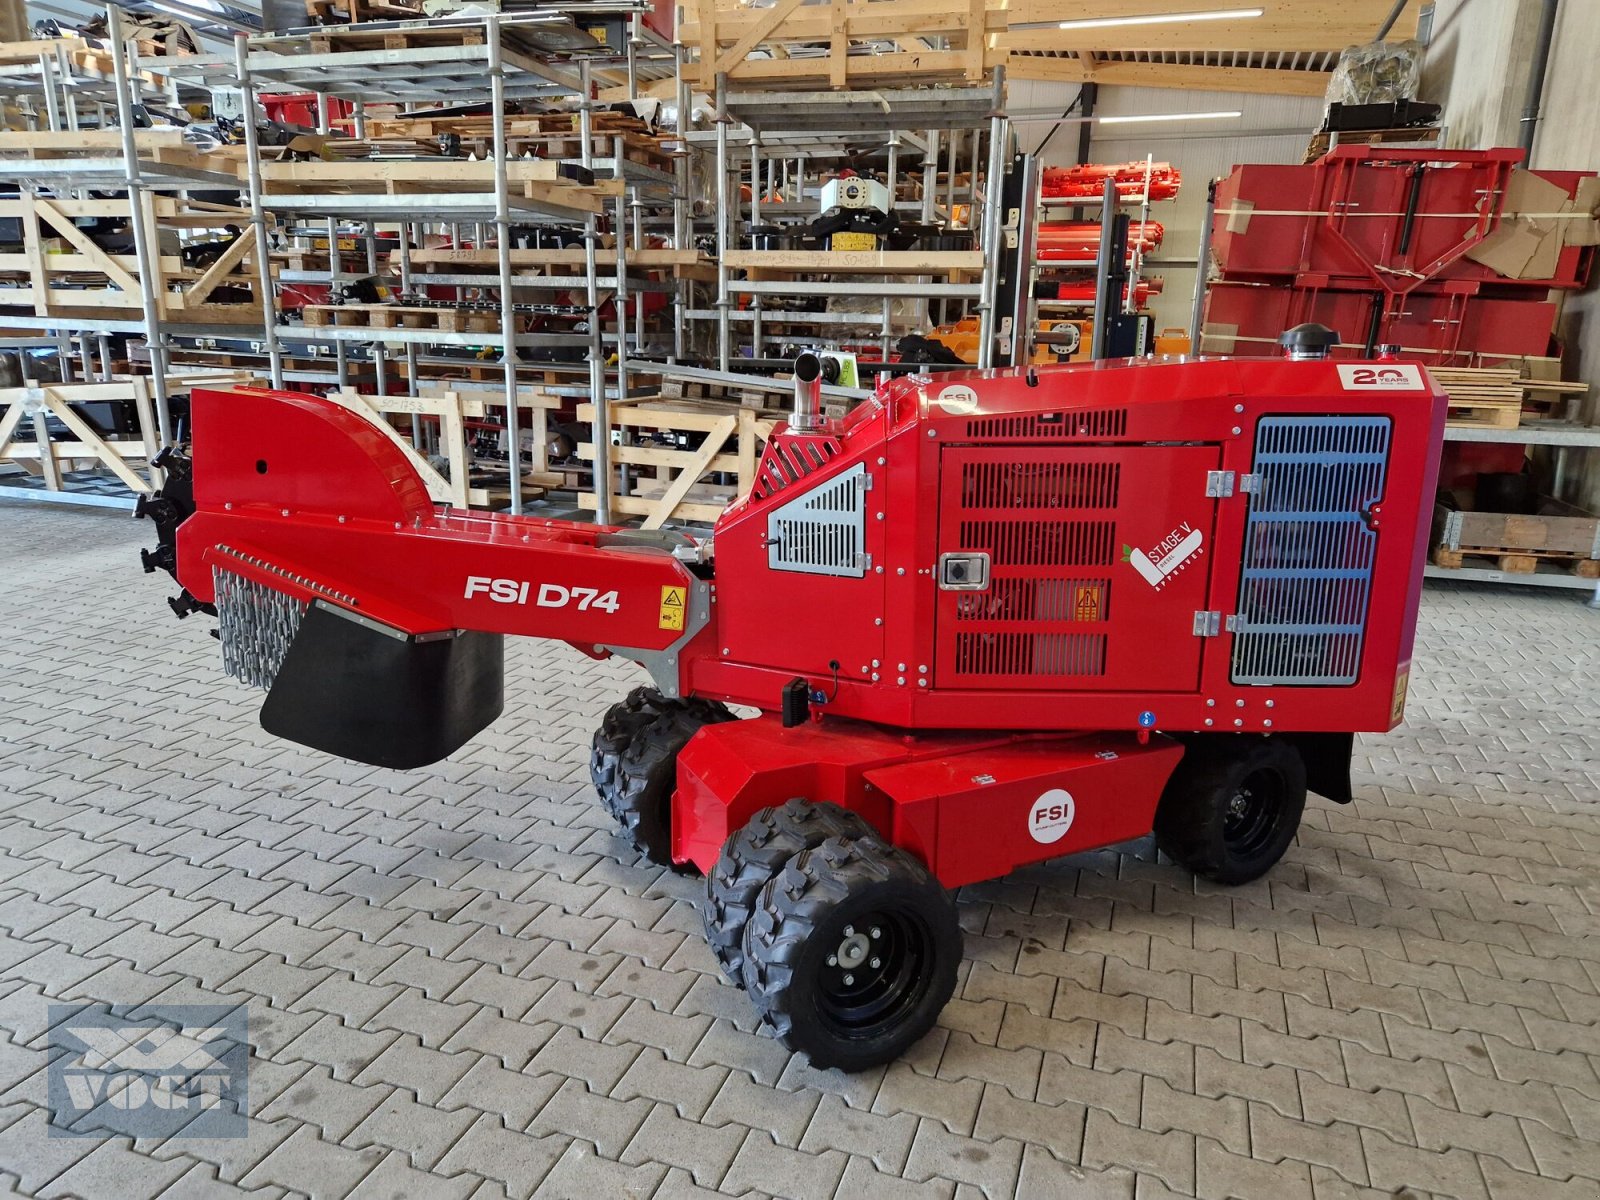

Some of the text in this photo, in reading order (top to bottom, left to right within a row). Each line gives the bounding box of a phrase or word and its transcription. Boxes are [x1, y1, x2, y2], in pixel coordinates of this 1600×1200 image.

[1148, 521, 1191, 563] STAGE V
[1155, 548, 1204, 592] APPROVED
[463, 576, 620, 614] FSI D74
[1035, 804, 1068, 824] FSI
